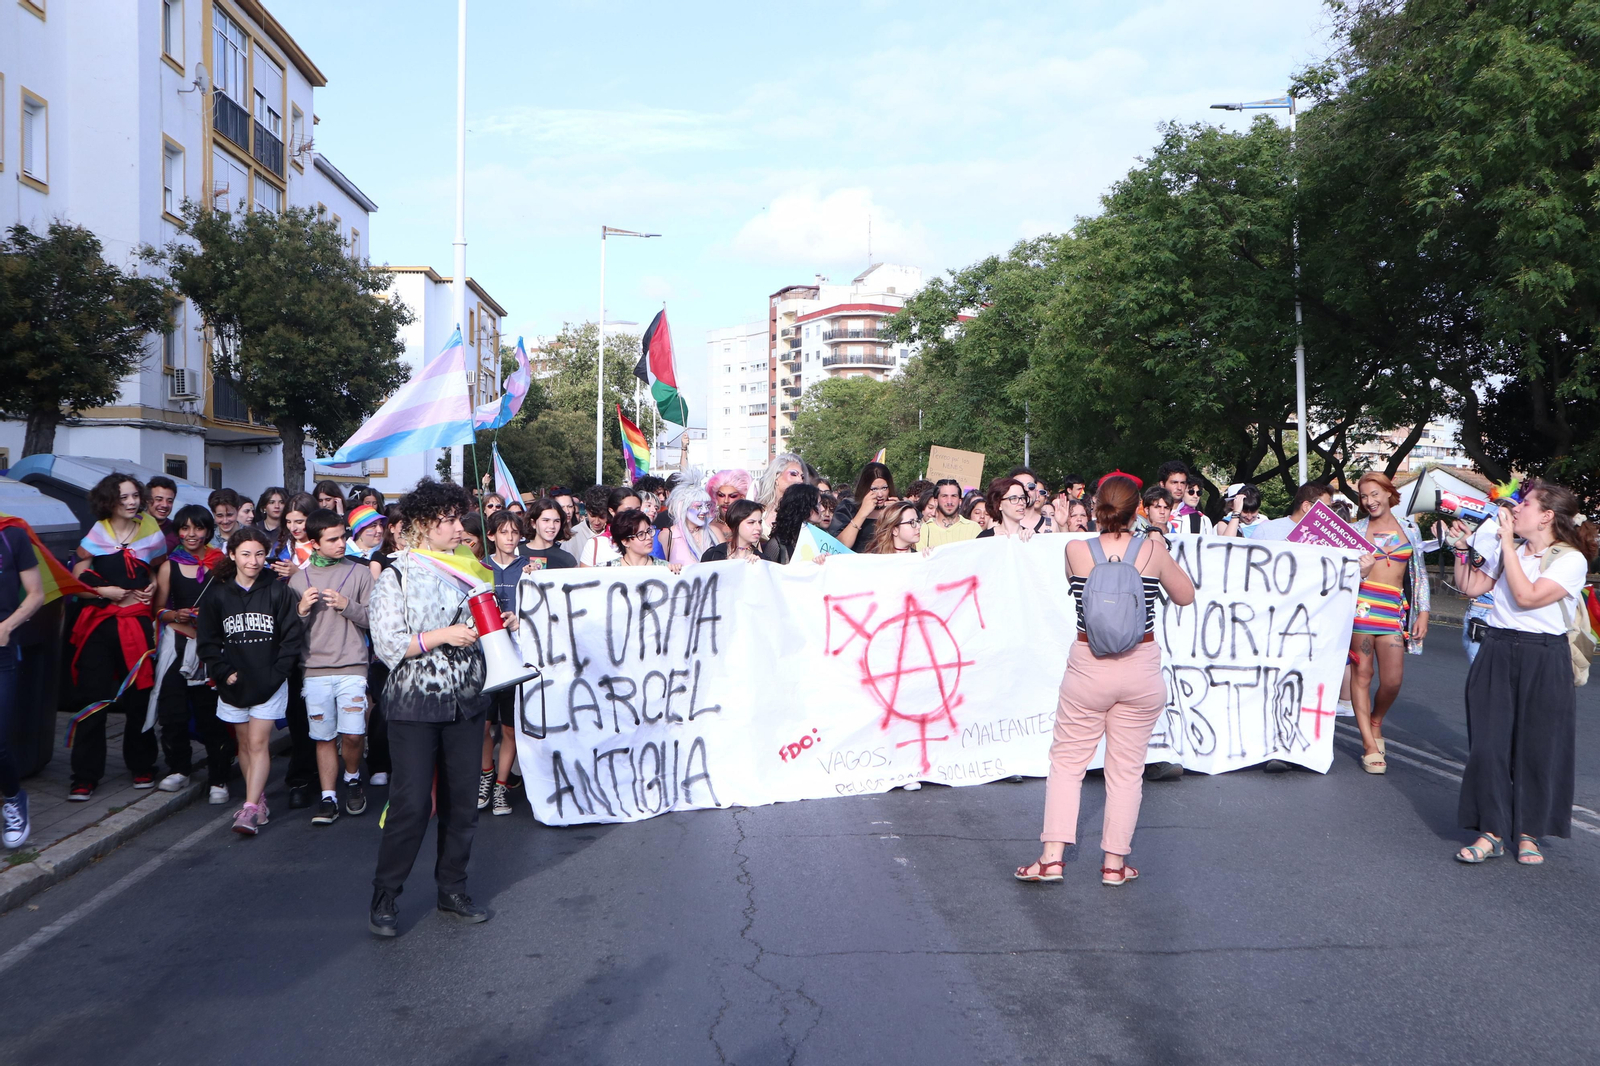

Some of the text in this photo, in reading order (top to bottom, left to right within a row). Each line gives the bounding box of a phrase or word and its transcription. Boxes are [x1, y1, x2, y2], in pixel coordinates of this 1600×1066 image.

[1312, 520, 1322, 529] SI
[1315, 508, 1330, 522] HOY
[1329, 521, 1357, 545] MARCHO
[519, 535, 1360, 677] REFORMA NTRO DE
[1160, 596, 1317, 661] MORIA
[228, 636, 273, 645] CLIFORNIA
[524, 659, 722, 734] CARCEL
[816, 711, 1056, 775] VAGOS, MALEANTES
[937, 758, 1007, 781] SOCIALES
[546, 736, 722, 819] ANTIGUA
